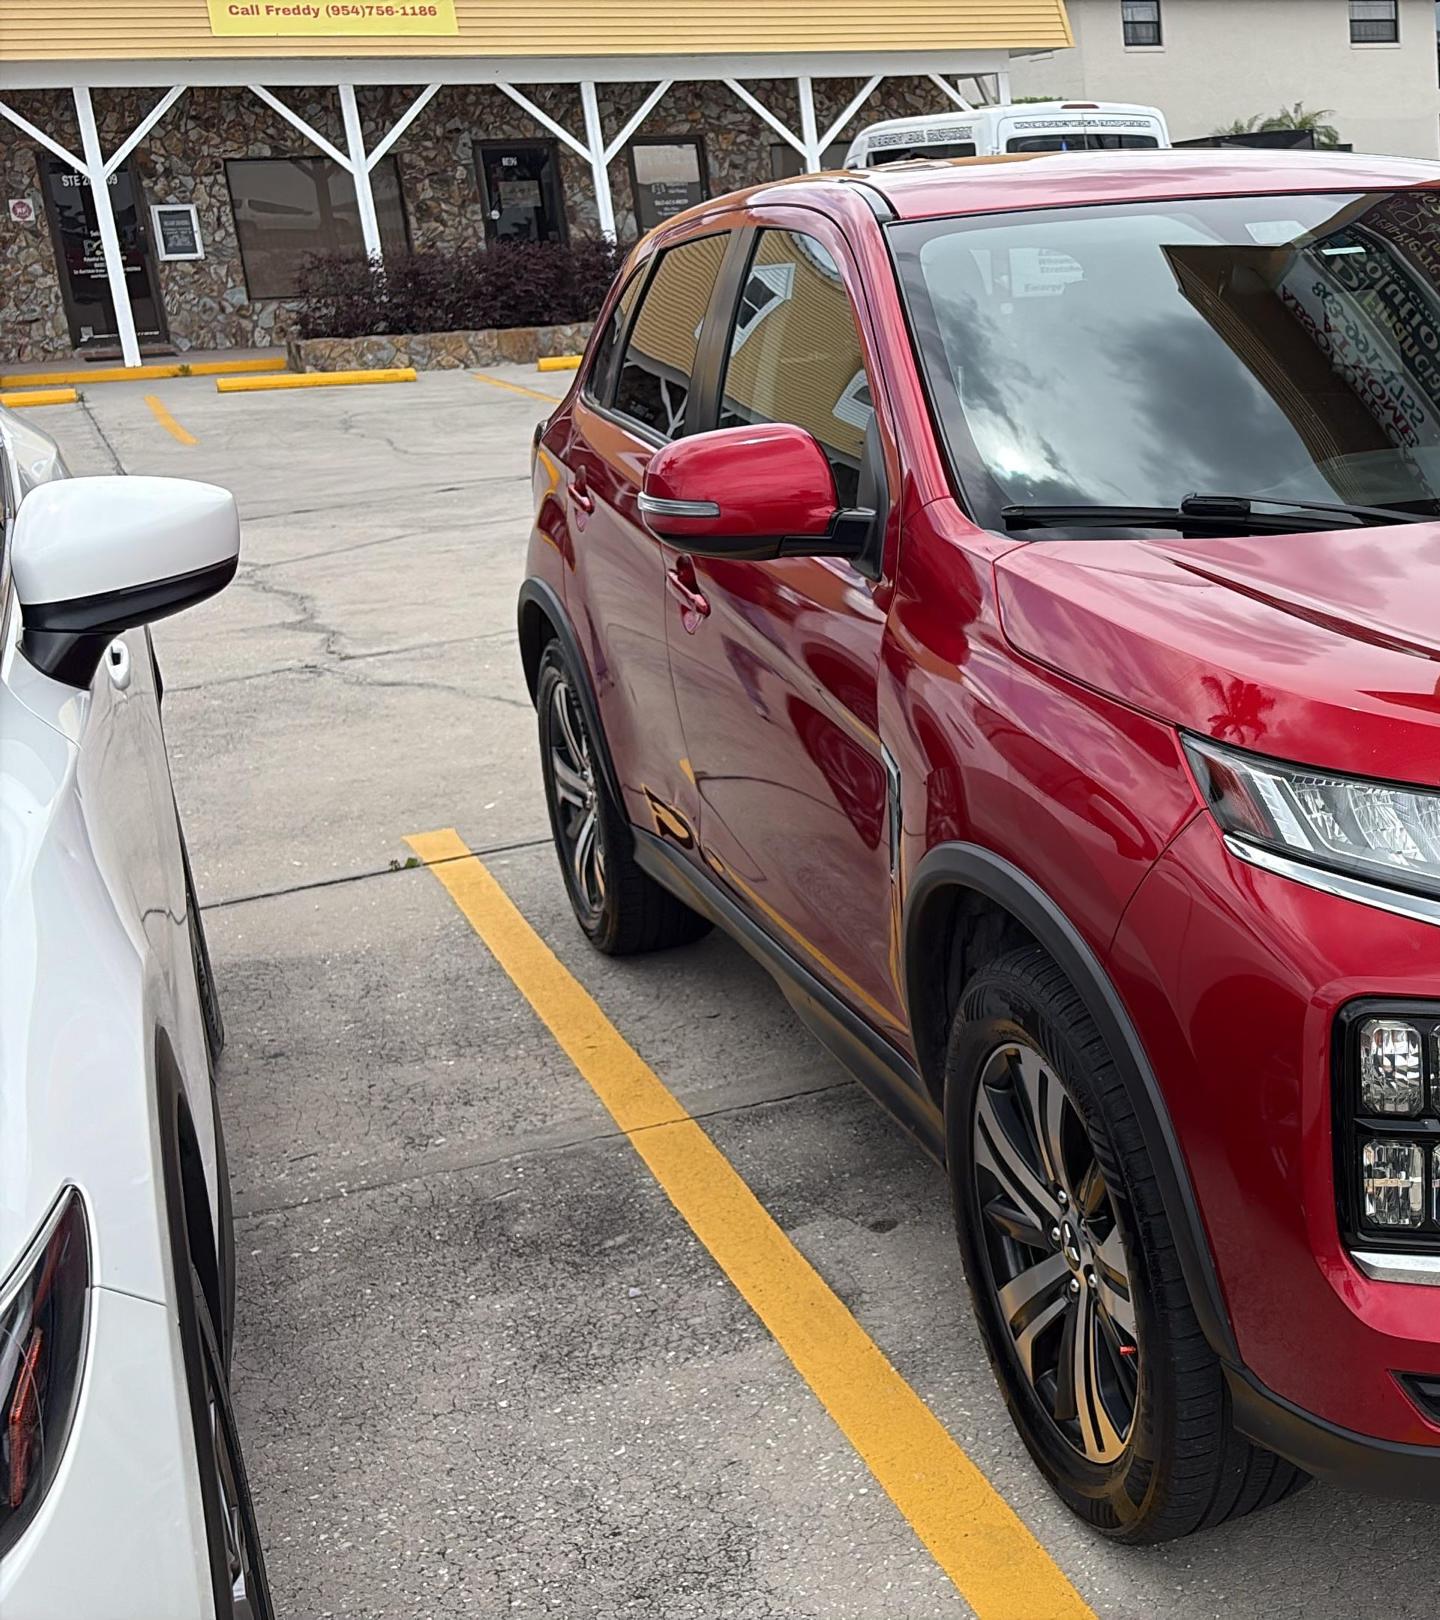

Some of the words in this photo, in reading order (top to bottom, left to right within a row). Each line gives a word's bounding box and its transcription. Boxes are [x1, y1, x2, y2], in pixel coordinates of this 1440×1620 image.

[228, 4, 260, 16] Call
[265, 4, 320, 18] Freddy
[325, 5, 438, 18] (954)756-1186
[61, 174, 81, 187] STE
